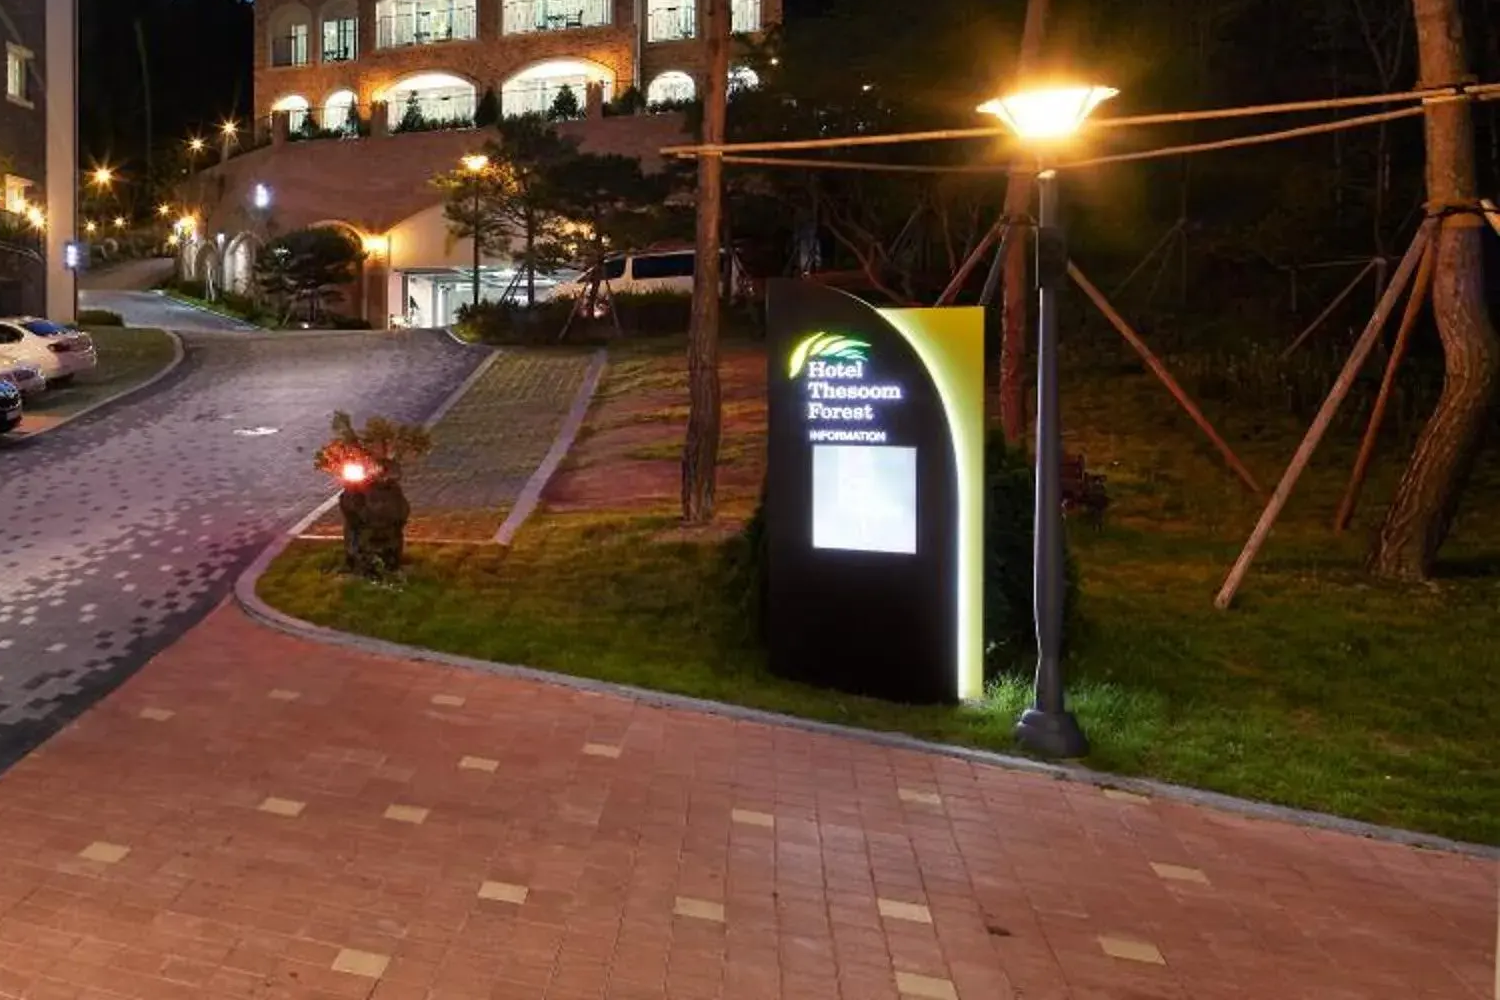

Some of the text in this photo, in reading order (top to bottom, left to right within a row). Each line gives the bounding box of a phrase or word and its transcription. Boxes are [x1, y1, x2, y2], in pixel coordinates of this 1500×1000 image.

[807, 360, 863, 378] Hotel
[807, 381, 903, 400] Thesoom
[807, 401, 874, 420] Forest
[809, 430, 886, 443] INFORMATION
